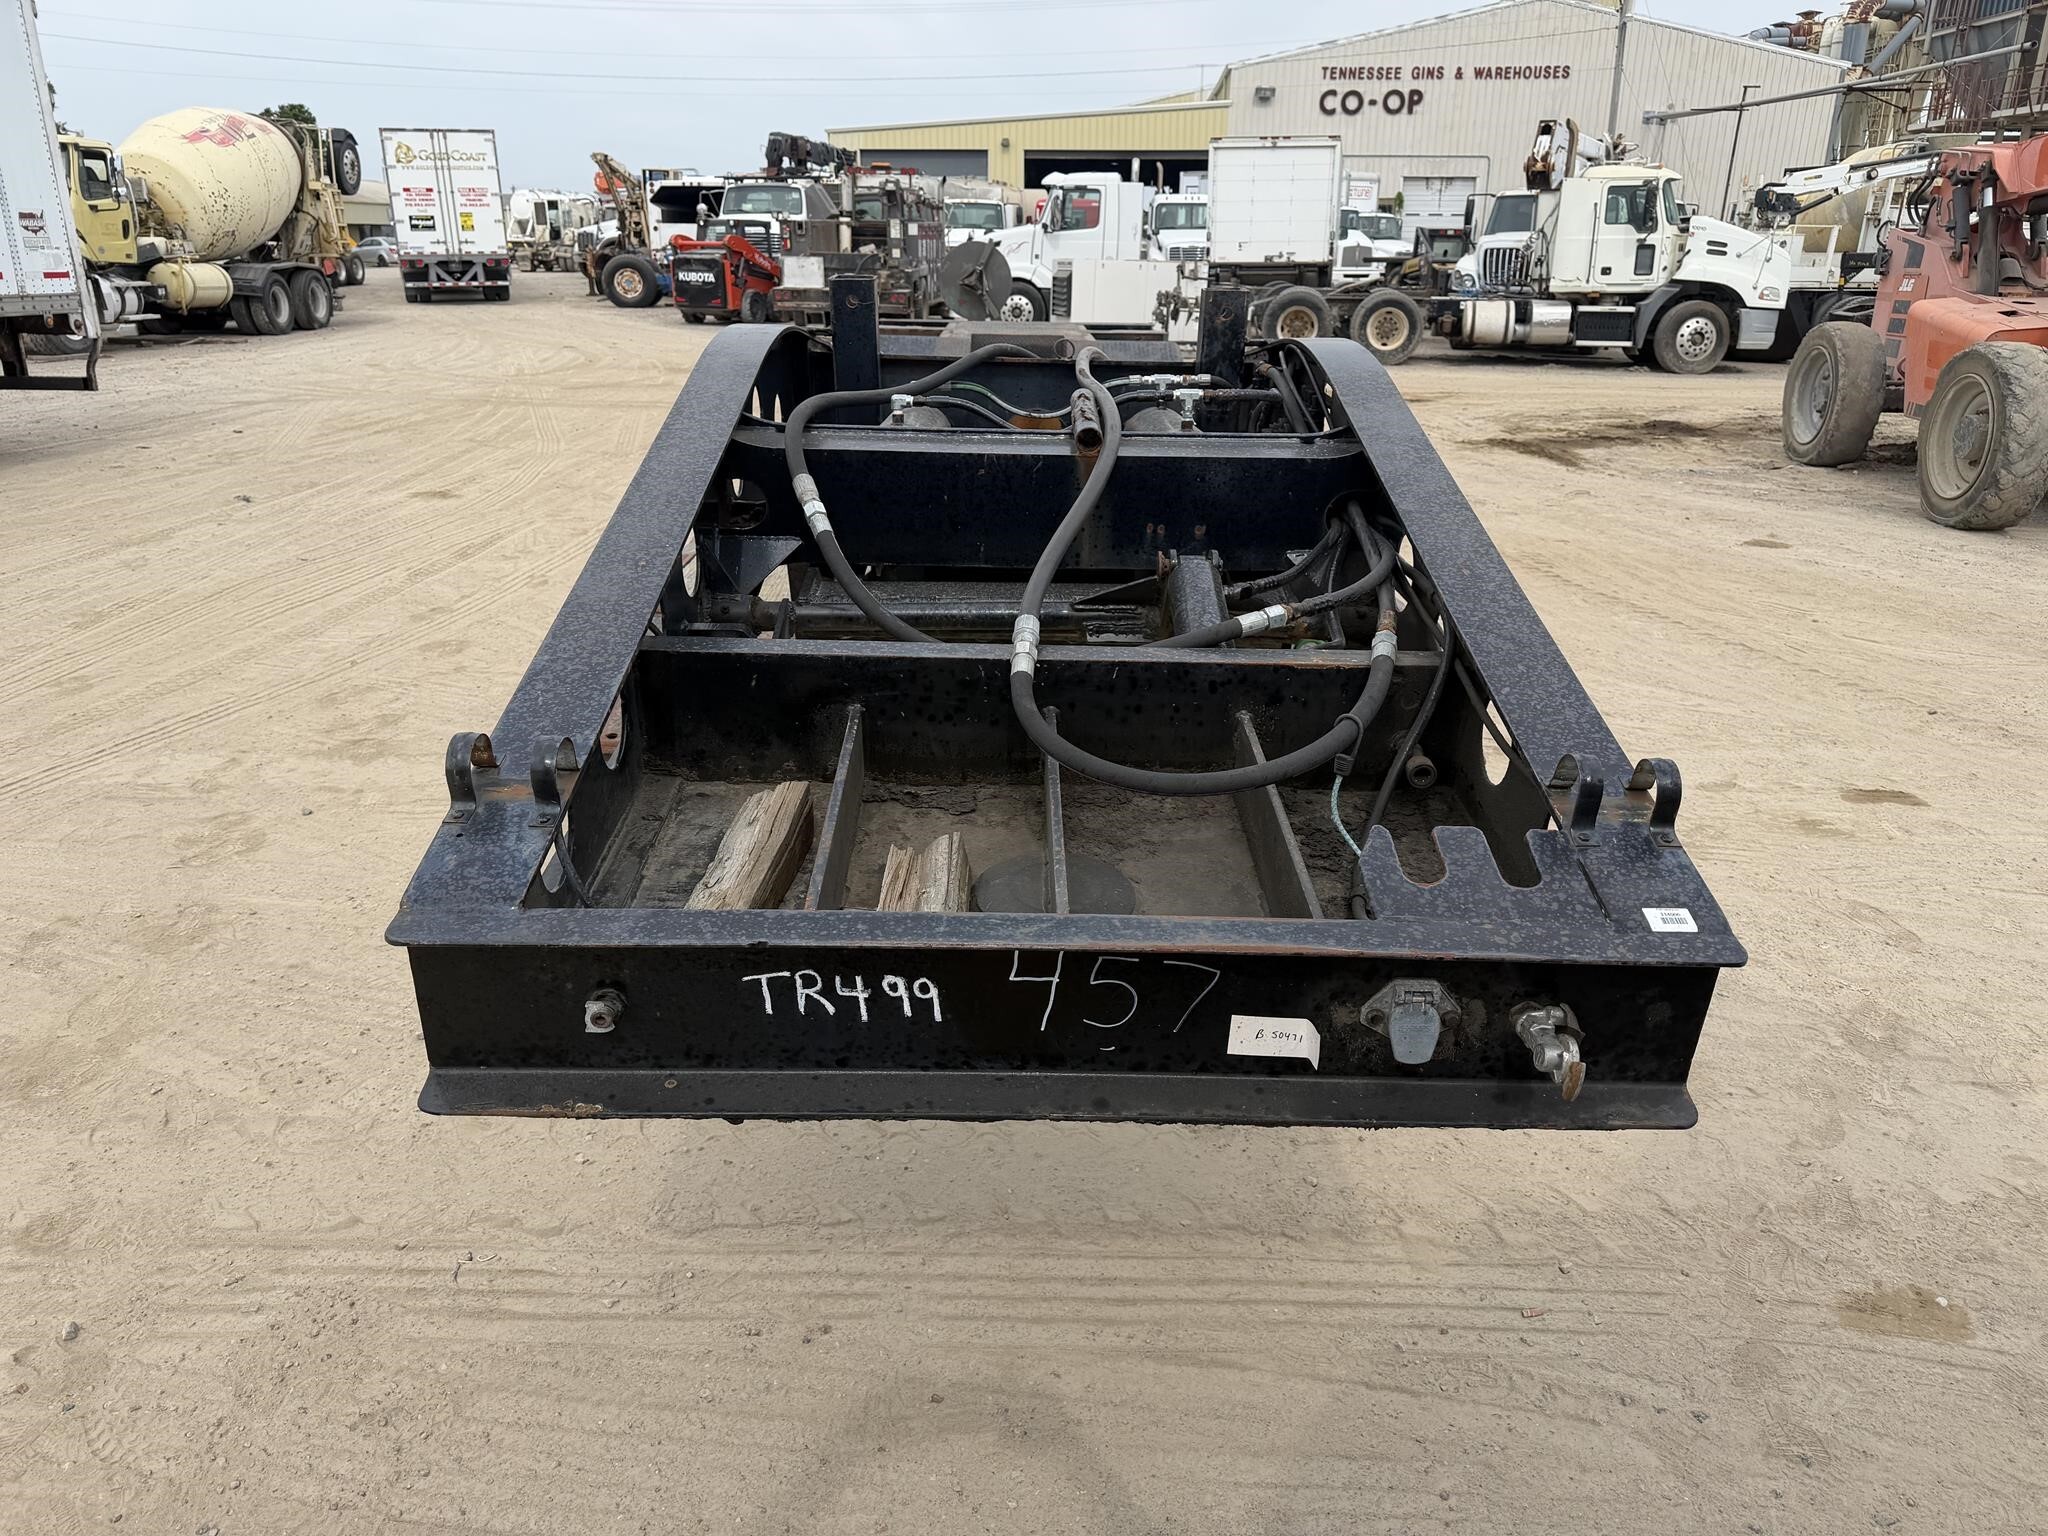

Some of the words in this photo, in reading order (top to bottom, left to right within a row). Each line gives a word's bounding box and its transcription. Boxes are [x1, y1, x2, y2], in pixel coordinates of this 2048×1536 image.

[1322, 66, 1402, 80] TENNESSEE
[1411, 66, 1445, 80] GINS
[1454, 67, 1464, 80] &
[1474, 65, 1571, 80] WAREHOUSES
[1319, 89, 1424, 116] CO-OP
[678, 271, 715, 283] KUBOTA
[1898, 278, 1915, 292] JLG
[742, 969, 943, 1022] TR499
[1009, 950, 1220, 1032] 457
